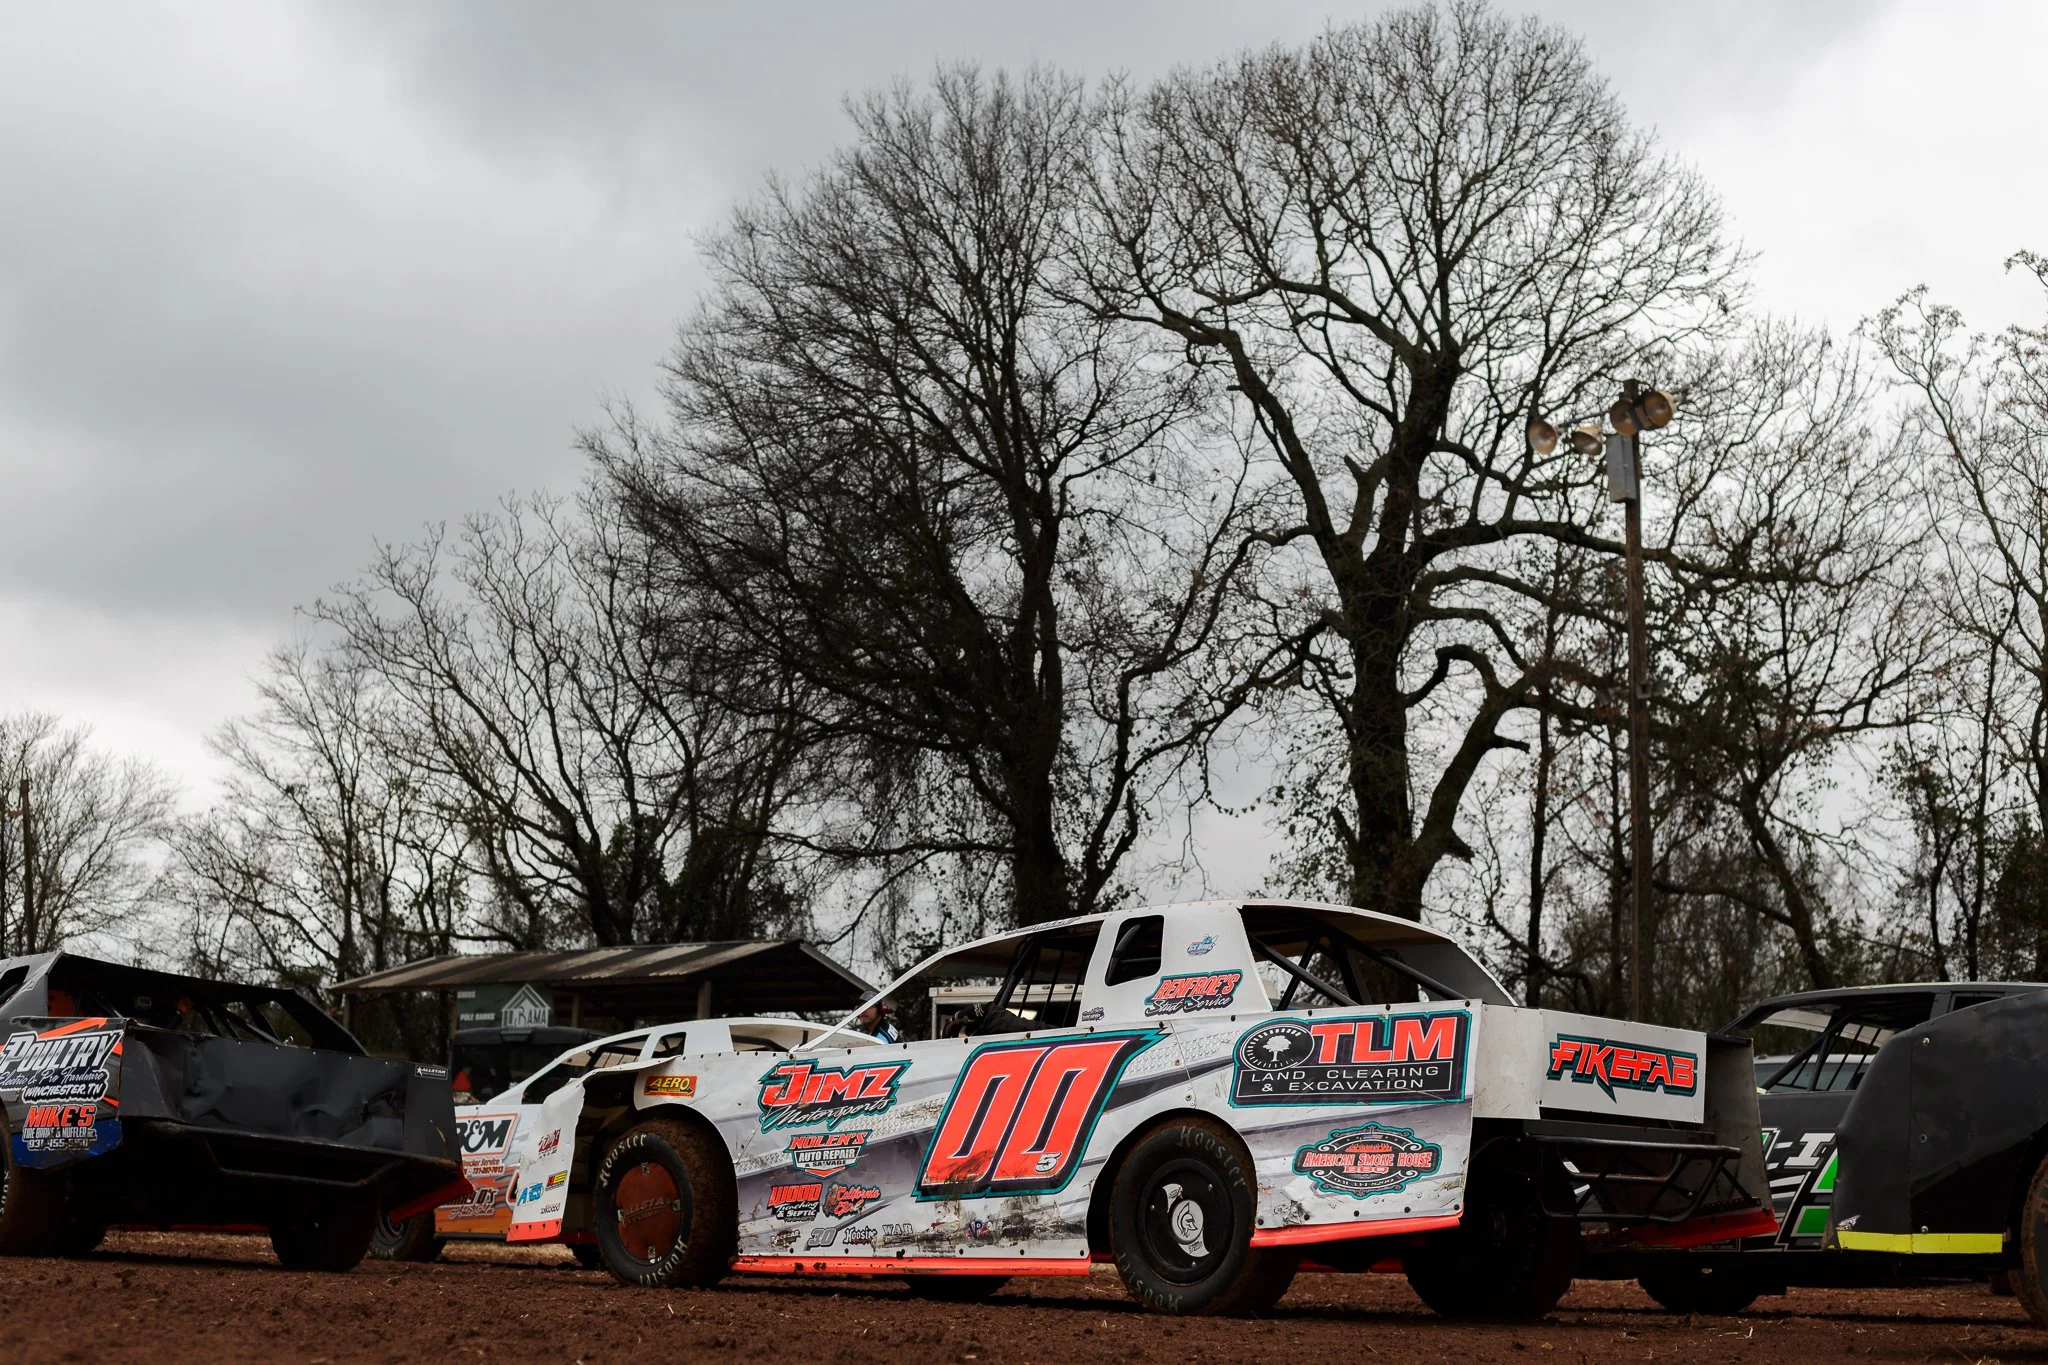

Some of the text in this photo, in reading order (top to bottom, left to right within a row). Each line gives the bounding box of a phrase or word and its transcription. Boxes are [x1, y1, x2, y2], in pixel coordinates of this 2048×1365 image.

[1152, 974, 1240, 1000] RENFROE'S
[1184, 994, 1231, 1009] Service
[1310, 1017, 1457, 1064] TLM
[0, 1033, 117, 1072] POULTRY
[1552, 1040, 1695, 1088] FIKEFAB
[39, 1067, 60, 1084] Pro
[61, 1066, 104, 1084] Hardware
[1251, 1066, 1440, 1082] LAND CLEARING
[650, 1077, 690, 1090] AERO
[762, 1064, 902, 1107] JIMZ
[1261, 1079, 1424, 1092] & EXCAVATION
[25, 1105, 95, 1128] MIKE'S
[763, 1097, 890, 1130] Motorsports
[921, 1040, 1129, 1187] 00
[62, 1127, 87, 1138] MUFFLER
[790, 1132, 868, 1149] NOLEN'S
[799, 1149, 855, 1162] AUTO REPAIR
[1035, 1153, 1062, 1172] 5
[1303, 1152, 1433, 1168] AMERICAN SMOKE HOUSE
[1343, 1165, 1389, 1175] BBQ
[768, 1183, 822, 1207] WOOD
[777, 1209, 817, 1218] & SEPTIC
[882, 1224, 913, 1235] WAR
